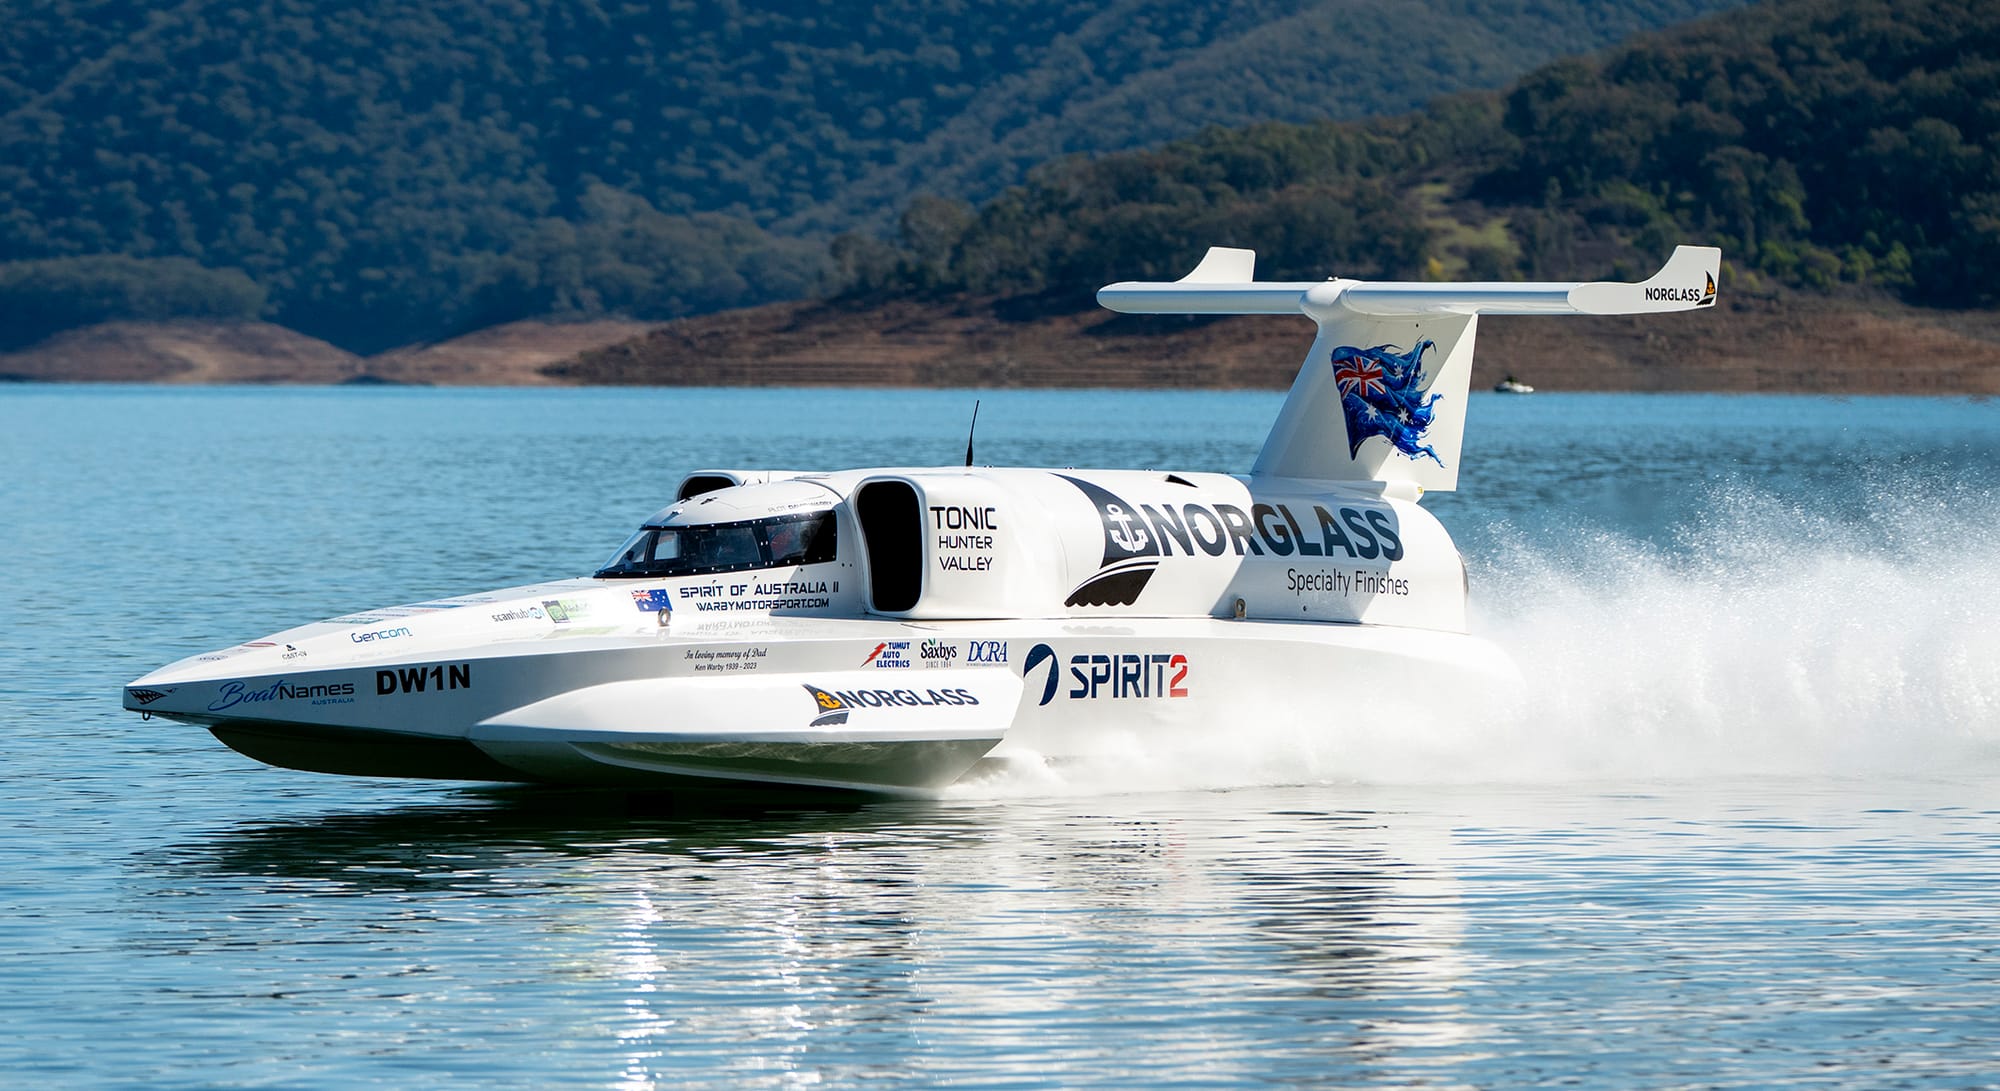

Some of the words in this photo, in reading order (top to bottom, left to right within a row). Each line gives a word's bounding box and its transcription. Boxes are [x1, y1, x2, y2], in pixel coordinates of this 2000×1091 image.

[1645, 287, 1700, 302] NORGLASS
[929, 506, 997, 530] TONIC
[1139, 503, 1405, 562] NORGLASS
[938, 535, 993, 549] HUNTER
[938, 556, 993, 571] VALLEY
[679, 585, 724, 599] SPIRIT
[729, 584, 748, 597] OF
[753, 581, 828, 596] AUSTRALIA
[1287, 568, 1351, 597] Specialty
[1355, 570, 1409, 596] Finishes
[696, 597, 830, 612] WARBYMOTORSPORT.COM
[350, 626, 411, 644] Gencom
[888, 641, 911, 650] TUMUT
[920, 641, 957, 661] Saxbys
[967, 640, 1008, 663] DCRA
[742, 648, 752, 660] of
[752, 647, 768, 658] Dad
[882, 650, 901, 659] AUTO
[694, 663, 706, 671] Ken
[706, 662, 725, 672] Warby
[876, 659, 911, 669] ELECTRICS
[376, 663, 471, 696] DW1N
[311, 698, 355, 706] AUSTRALIA
[835, 685, 980, 709] NORGLASS
